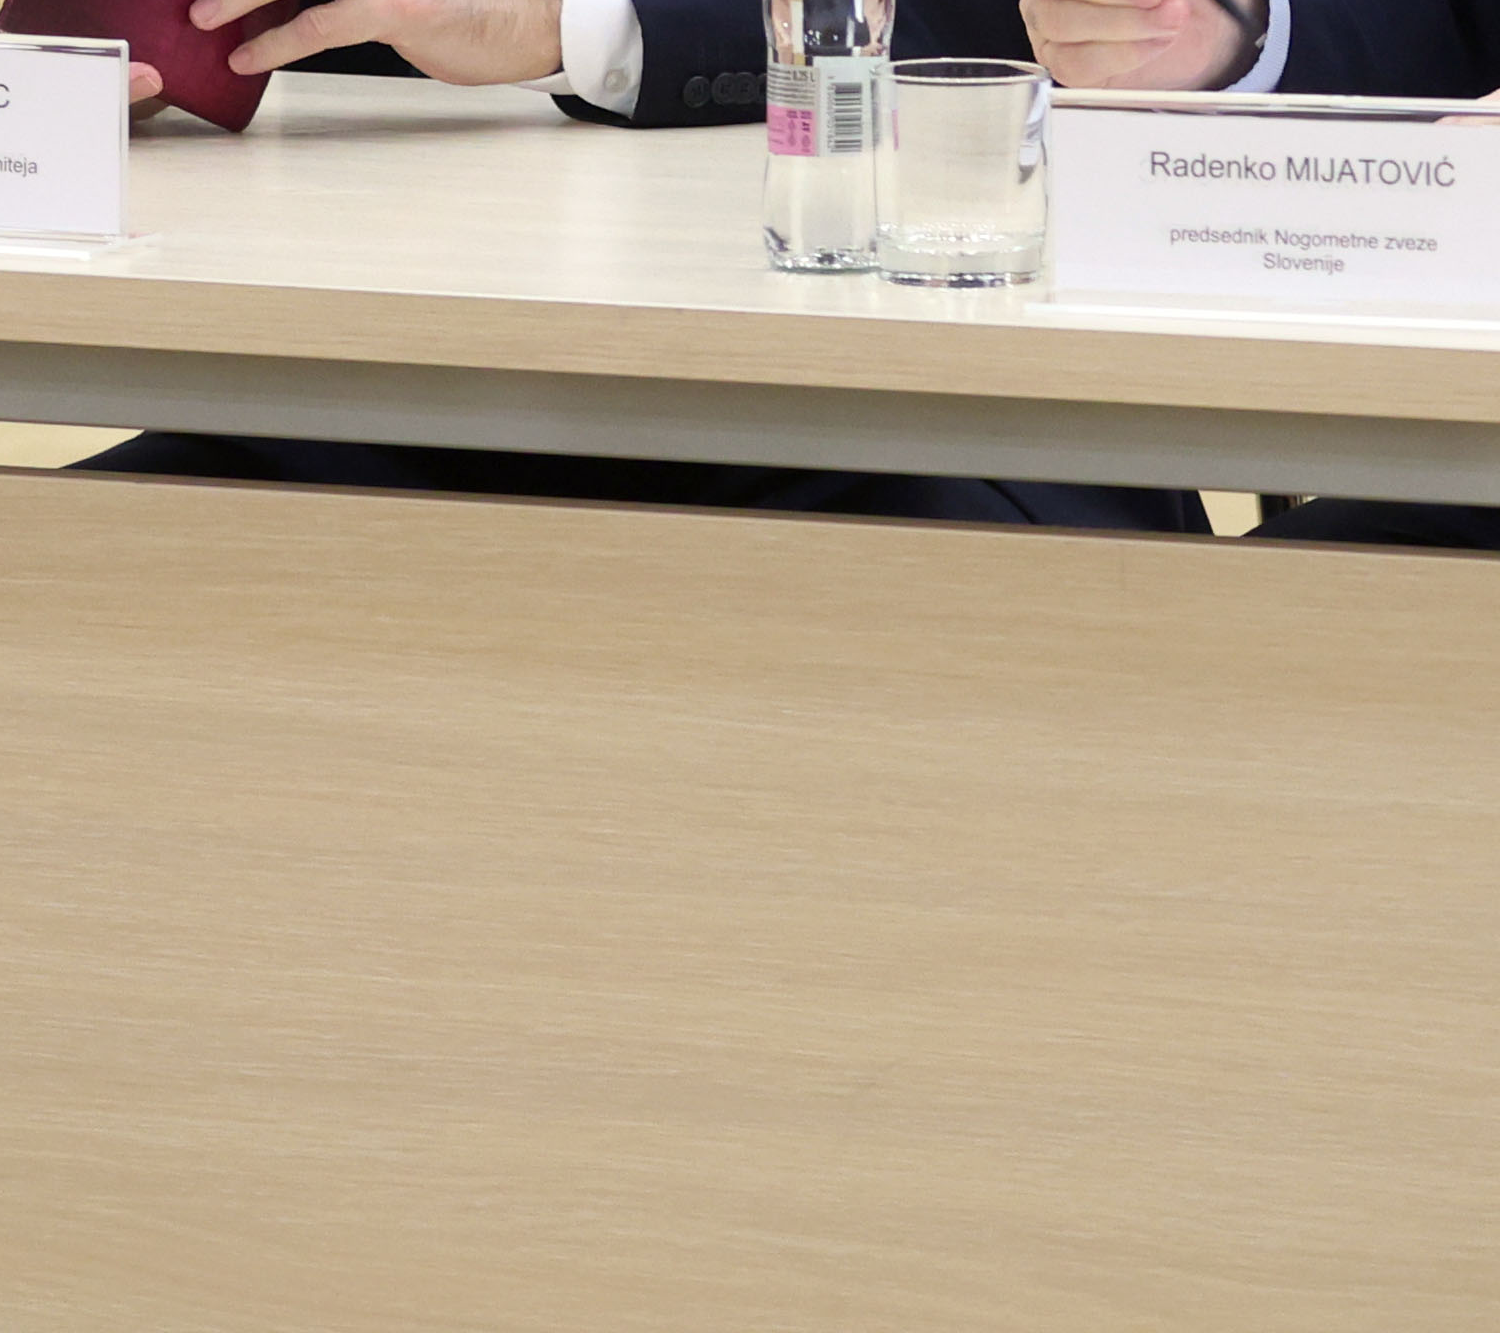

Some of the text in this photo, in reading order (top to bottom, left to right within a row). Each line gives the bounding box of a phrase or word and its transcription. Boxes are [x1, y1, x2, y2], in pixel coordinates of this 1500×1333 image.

[1150, 151, 1456, 187] Radenko MIJATOVIĆ
[1170, 226, 1438, 252] predsednik Nogometne zveze
[1263, 252, 1345, 275] Slovenije
